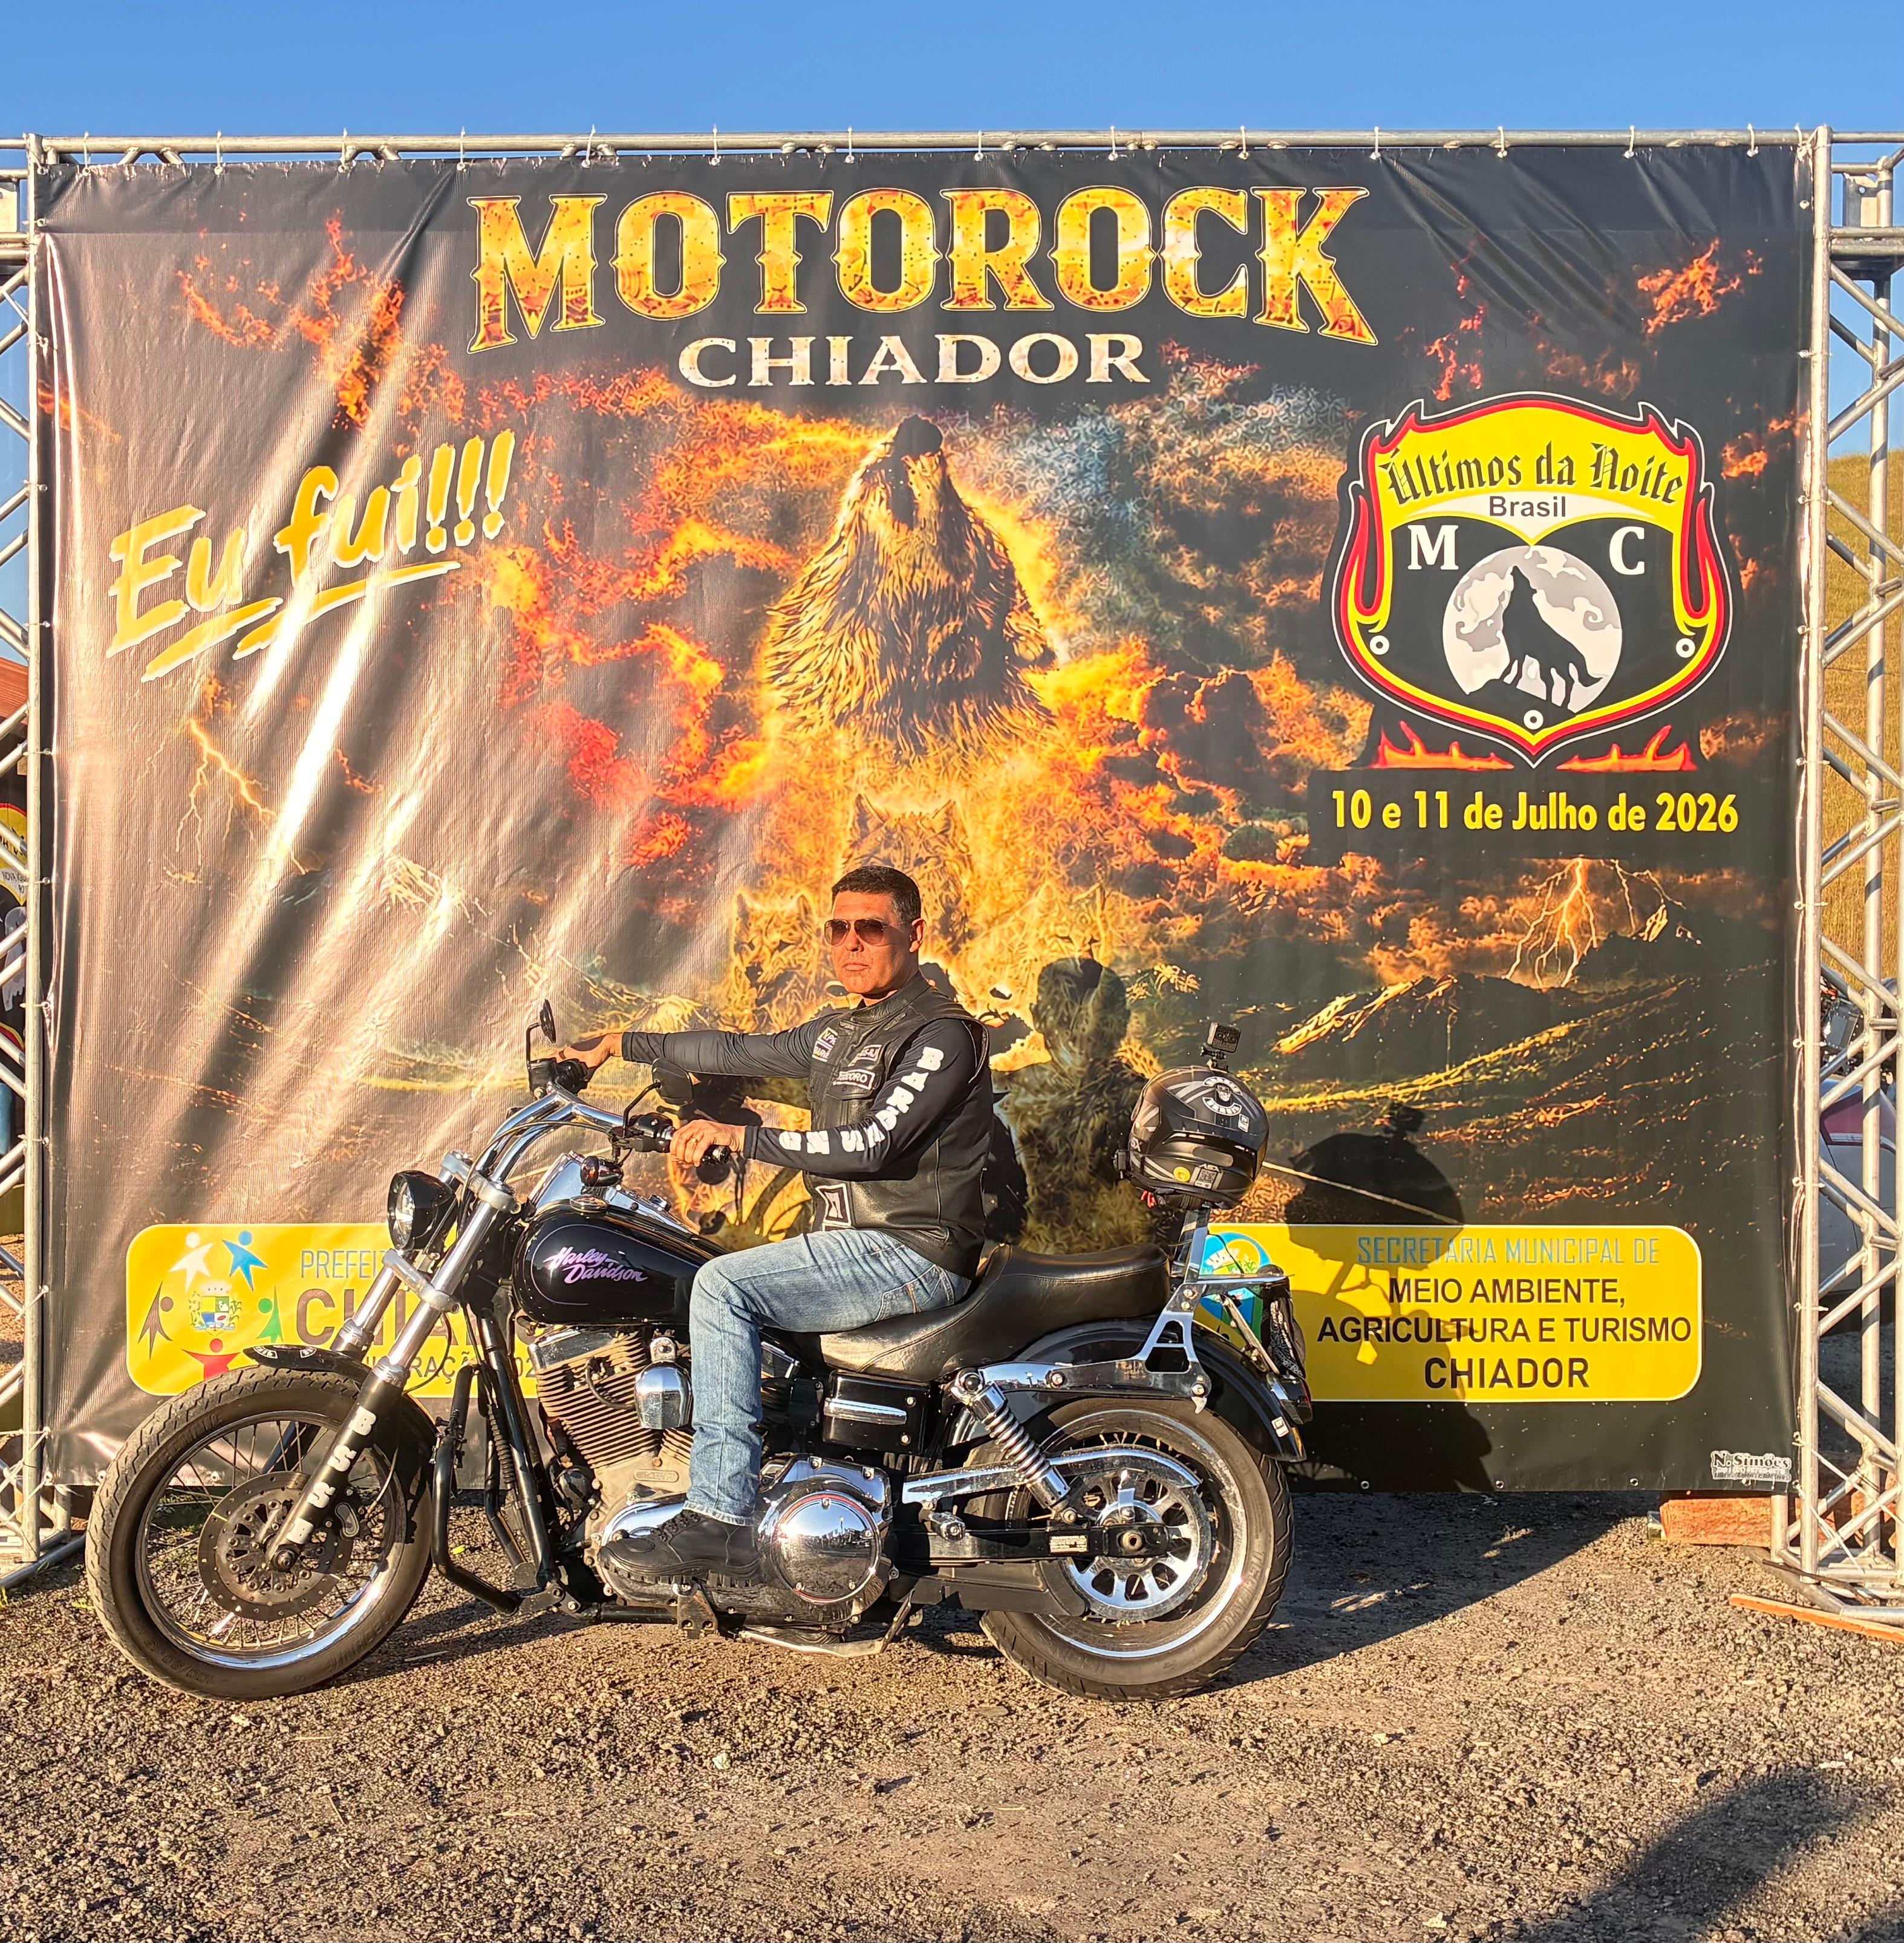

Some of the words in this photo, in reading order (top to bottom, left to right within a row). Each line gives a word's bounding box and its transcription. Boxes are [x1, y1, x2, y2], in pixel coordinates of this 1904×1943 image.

[466, 184, 1379, 354] MOTOROCK
[678, 332, 1150, 388] CHIADOR
[1378, 446, 1523, 506] Últimos
[1534, 440, 1577, 487] da
[1589, 441, 1686, 506] Noite
[1488, 494, 1567, 519] Brasil
[105, 503, 249, 659] Eu
[273, 428, 516, 589] fui!!!
[1407, 524, 1459, 571] M
[1608, 525, 1646, 576] C
[1331, 789, 1372, 830] 10
[1381, 801, 1403, 830] e
[1413, 790, 1449, 830] 11
[1463, 791, 1504, 832] de
[1511, 790, 1598, 833] Julho
[1607, 792, 1647, 833] de
[1655, 793, 1739, 834] 2026
[301, 1250, 386, 1278] PREFEI
[543, 1246, 619, 1269] Harley
[1357, 1235, 1497, 1266] SECRETARIA
[1505, 1237, 1625, 1265] MUNICIPAL
[1635, 1238, 1660, 1264] DE
[562, 1263, 648, 1284] Davidson
[1389, 1277, 1462, 1304] MEIO
[1469, 1277, 1626, 1309] AMBIENTE,
[1316, 1316, 1531, 1344] AGRICULTURA
[1538, 1316, 1556, 1343] E
[1563, 1316, 1692, 1344] TURISMO
[1423, 1356, 1590, 1389] CHIADOR
